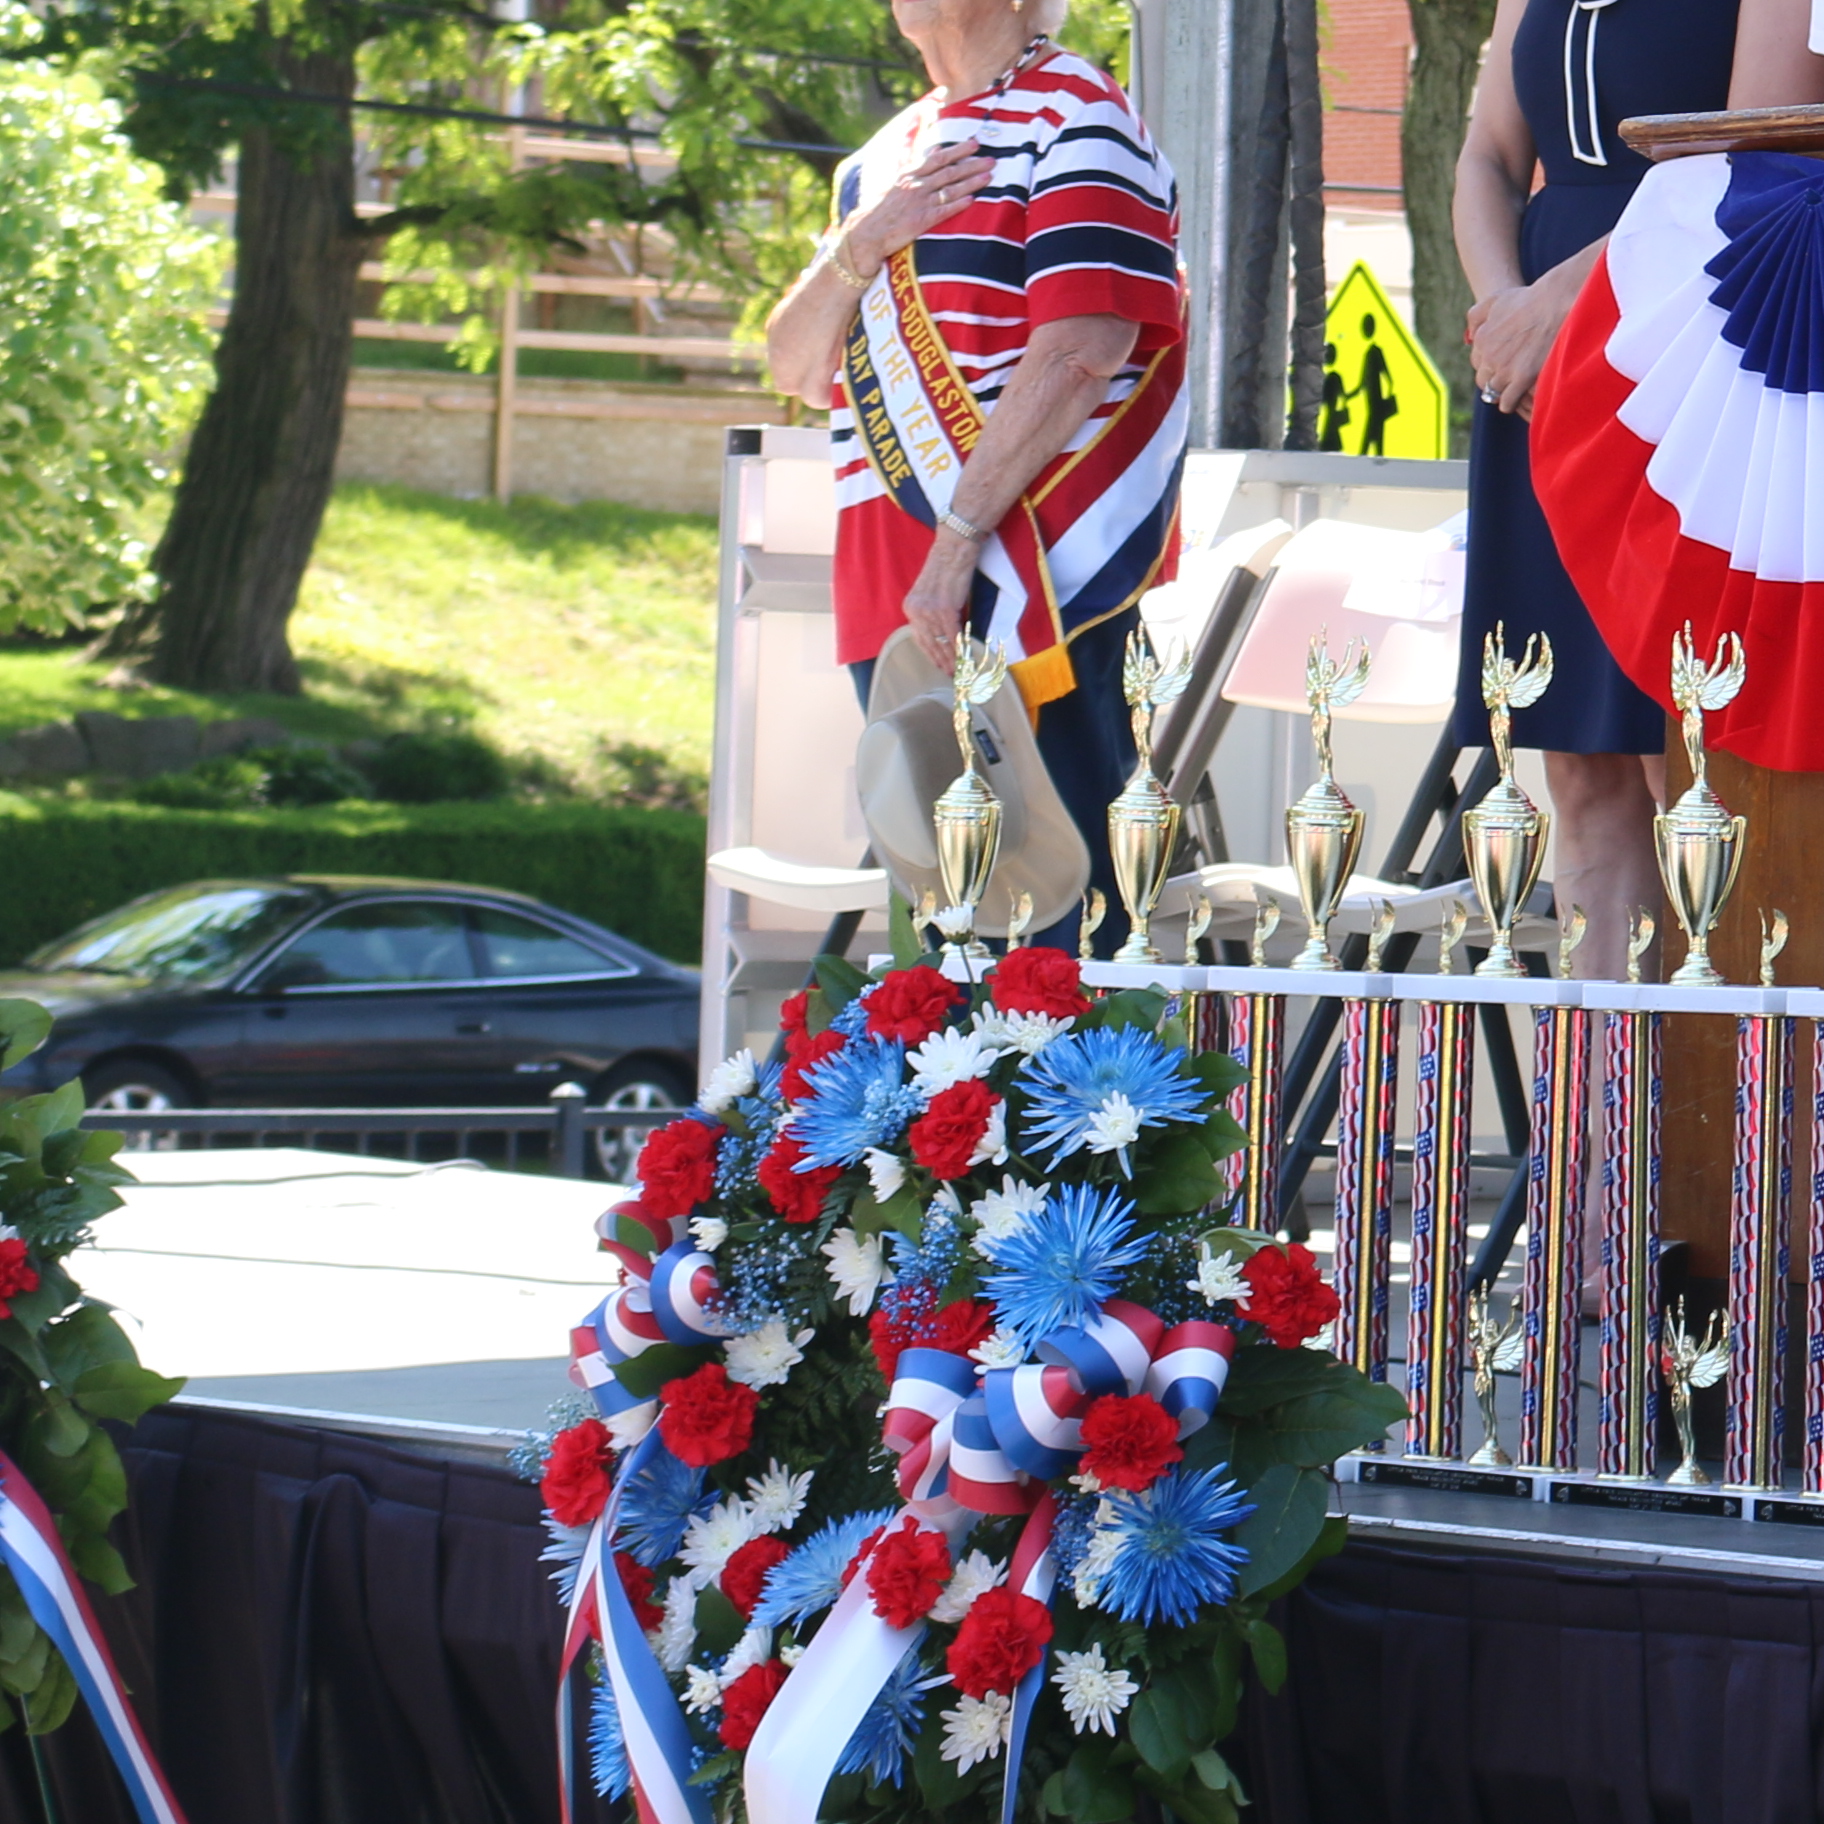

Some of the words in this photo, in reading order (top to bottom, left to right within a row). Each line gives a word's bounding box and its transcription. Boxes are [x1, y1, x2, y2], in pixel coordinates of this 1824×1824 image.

[868, 287, 891, 324] OF
[850, 332, 873, 384] DAY
[877, 331, 915, 393] THE
[860, 389, 913, 489] PARADE
[898, 392, 951, 481] YEAR
